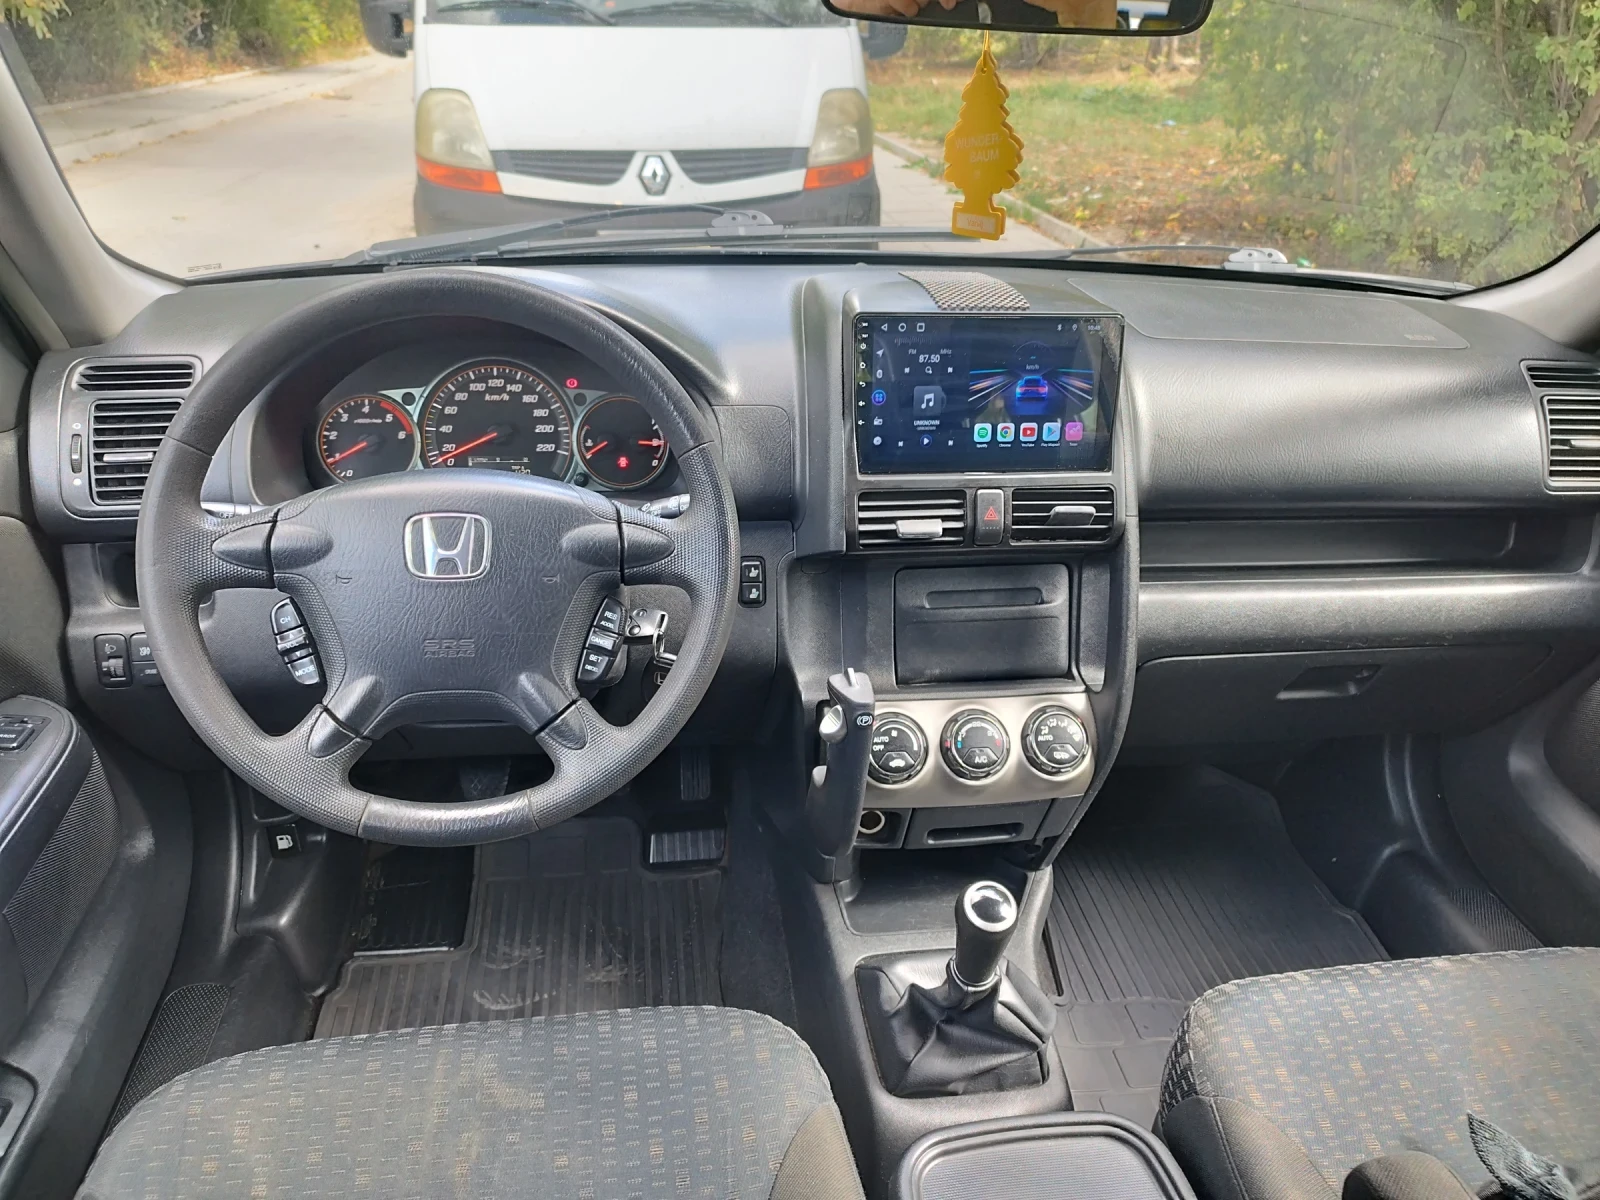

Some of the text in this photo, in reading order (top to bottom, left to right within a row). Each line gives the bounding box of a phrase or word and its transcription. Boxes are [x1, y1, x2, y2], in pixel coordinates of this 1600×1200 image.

[969, 148, 1000, 163] BAUM
[918, 354, 940, 363] 87.50
[469, 382, 486, 392] 100
[487, 378, 505, 387] 120
[506, 383, 522, 392] 140
[454, 392, 468, 401] 80
[484, 393, 510, 401] km/h
[522, 394, 538, 403] 160
[361, 405, 370, 414] 4
[444, 406, 458, 415] 60
[532, 408, 549, 417] 180
[340, 413, 349, 423] 3
[385, 413, 393, 423] 5
[439, 425, 453, 433] 40
[534, 424, 554, 433] 200
[329, 431, 338, 440] 2
[398, 431, 407, 440] 6
[442, 443, 456, 452] 20
[536, 443, 555, 452] 220
[447, 458, 455, 466] 0
[651, 459, 659, 467] 0
[346, 469, 353, 477] 0
[280, 615, 291, 624] CH
[604, 610, 618, 620] RES
[424, 637, 475, 649] SRS
[424, 650, 476, 658] AIRBAG
[589, 654, 603, 663] SET
[294, 664, 316, 678] MODE
[974, 755, 988, 763] A/C
